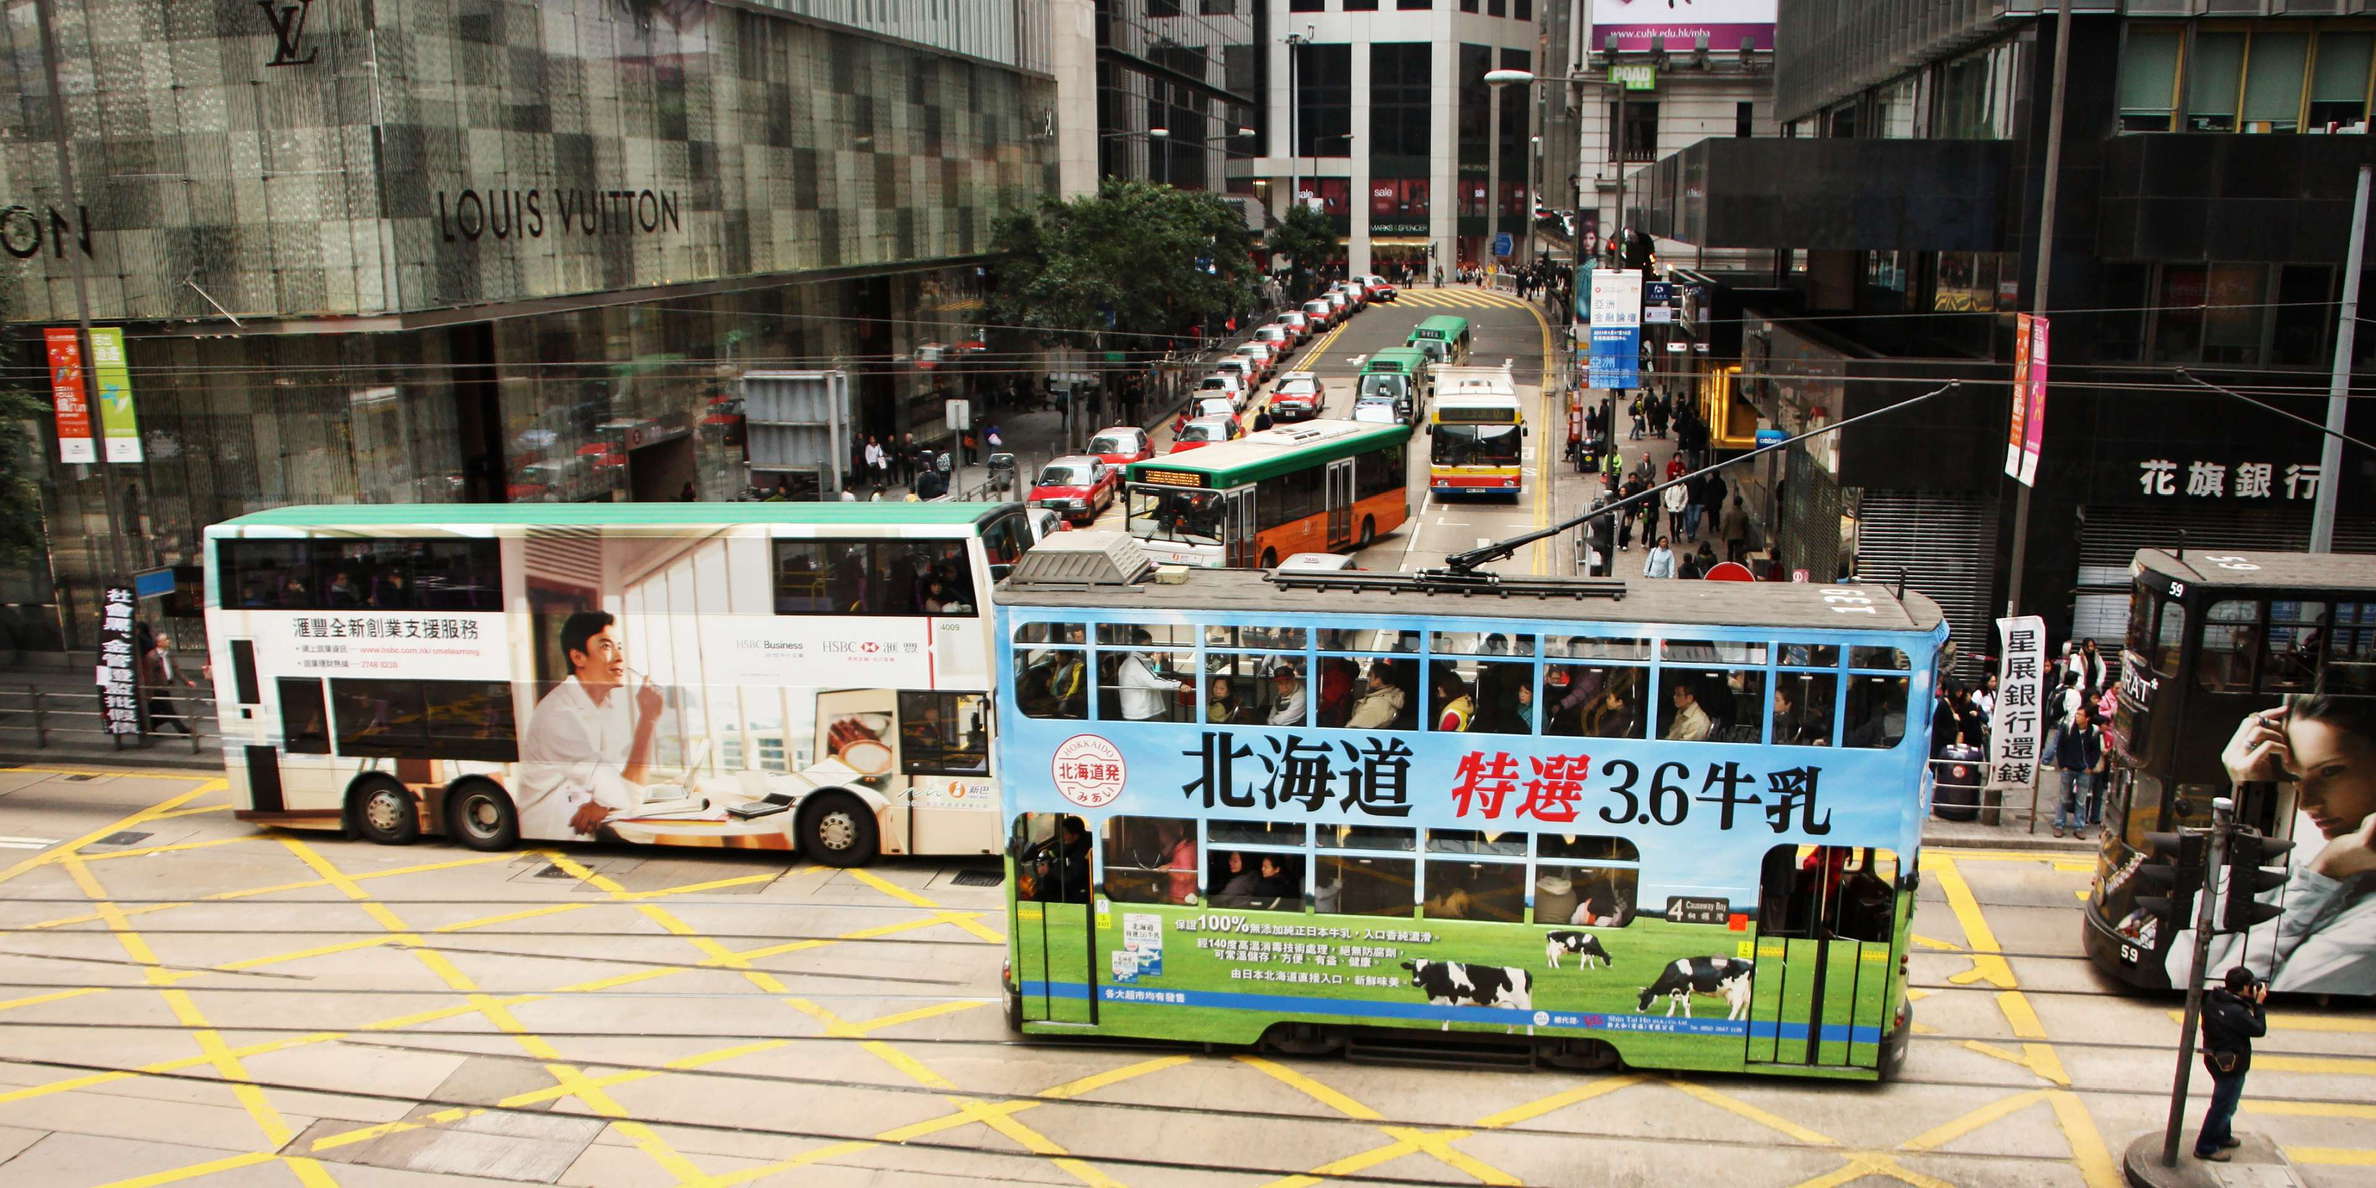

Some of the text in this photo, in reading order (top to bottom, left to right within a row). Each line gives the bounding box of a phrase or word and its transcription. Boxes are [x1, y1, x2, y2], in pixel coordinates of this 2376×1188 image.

[1609, 28, 1711, 40] www.cuhkedu.hk/mba
[1374, 187, 1392, 197] sale
[438, 188, 680, 243] LOUIS VUITTON
[2139, 459, 2322, 500] 花旗銀行
[2168, 581, 2184, 597] 59
[939, 623, 961, 632] 4009
[763, 639, 804, 650] Business
[822, 640, 857, 653] HSBC
[1997, 629, 2038, 785] 星展銀行還錢
[1063, 739, 1115, 758] HOKKAIDO
[1058, 762, 1120, 781] 北海道発
[1181, 731, 1415, 817] 北海道
[1451, 750, 1593, 824] 特選
[1599, 758, 1832, 836] 3.6牛乳
[1667, 898, 1684, 922] 4
[1685, 900, 1728, 911] Causeway Bay
[2121, 944, 2139, 963] 59
